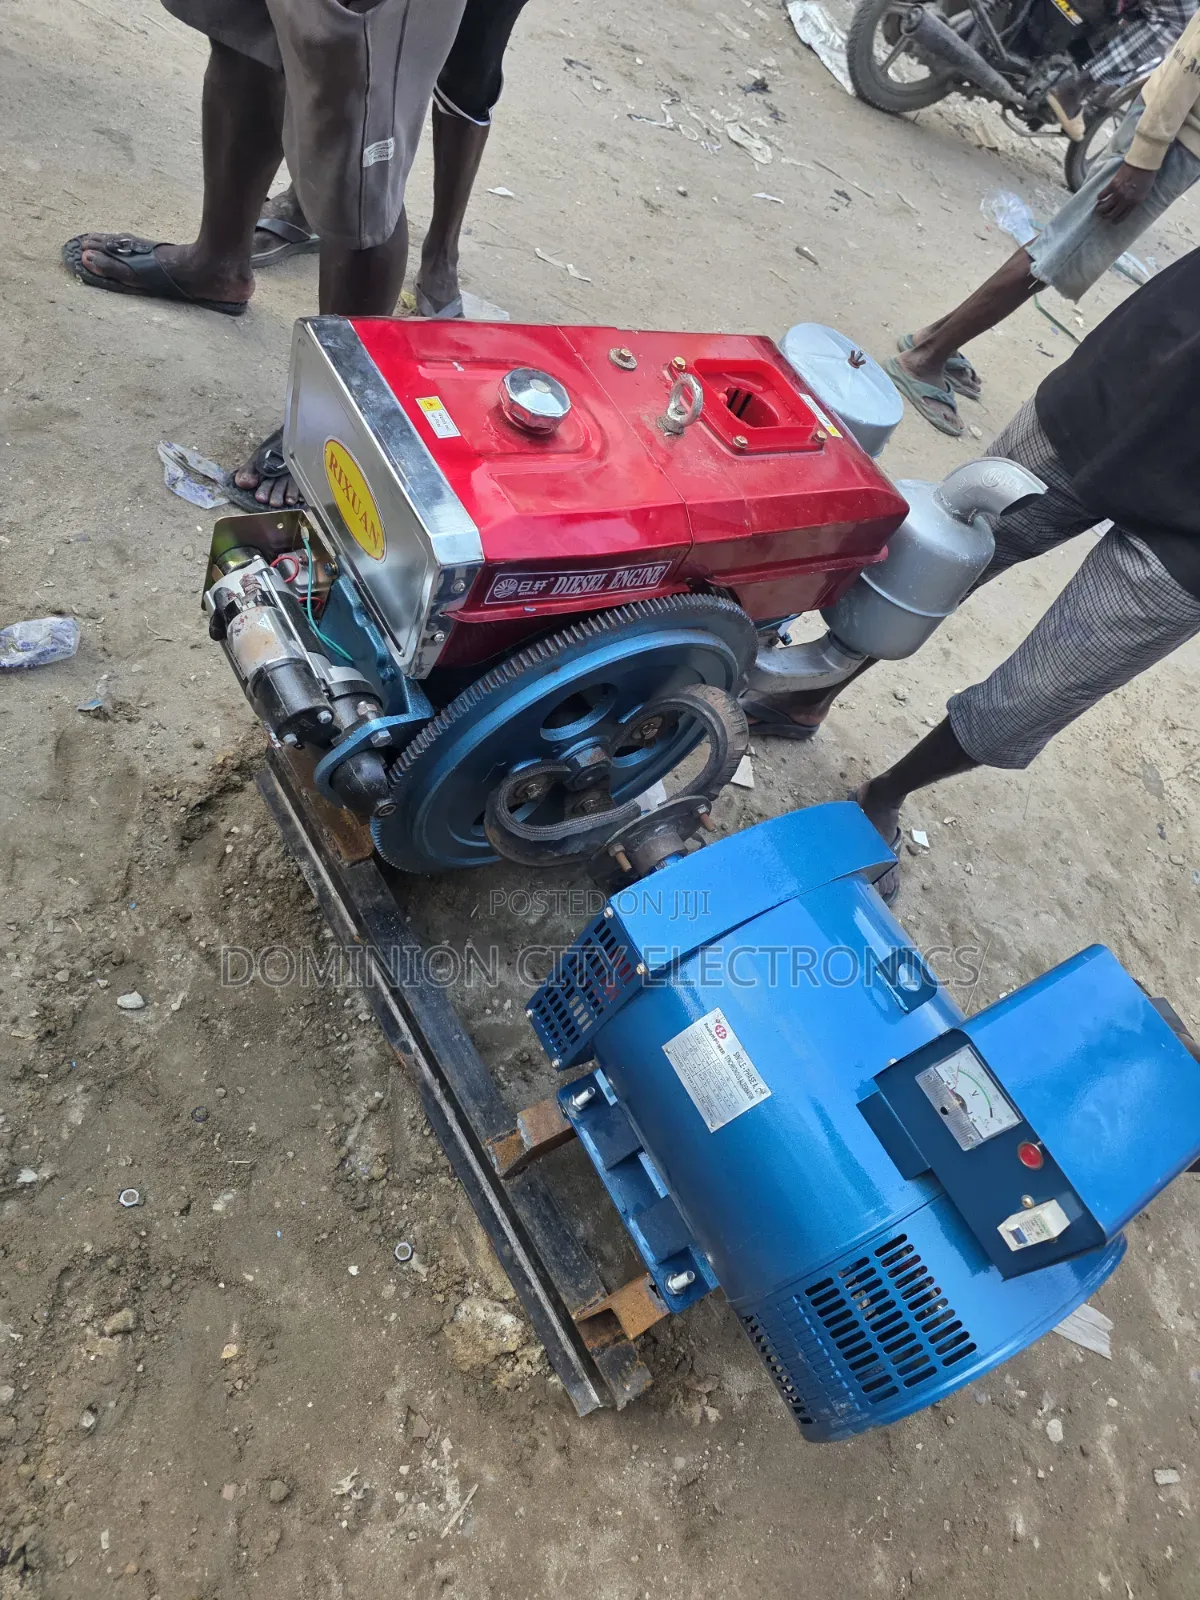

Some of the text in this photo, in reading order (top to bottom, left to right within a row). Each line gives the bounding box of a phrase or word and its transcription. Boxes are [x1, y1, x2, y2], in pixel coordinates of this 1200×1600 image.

[328, 450, 380, 549] RIXUAN
[550, 566, 666, 595] DIESEL ENGINE
[970, 1089, 979, 1098] V
